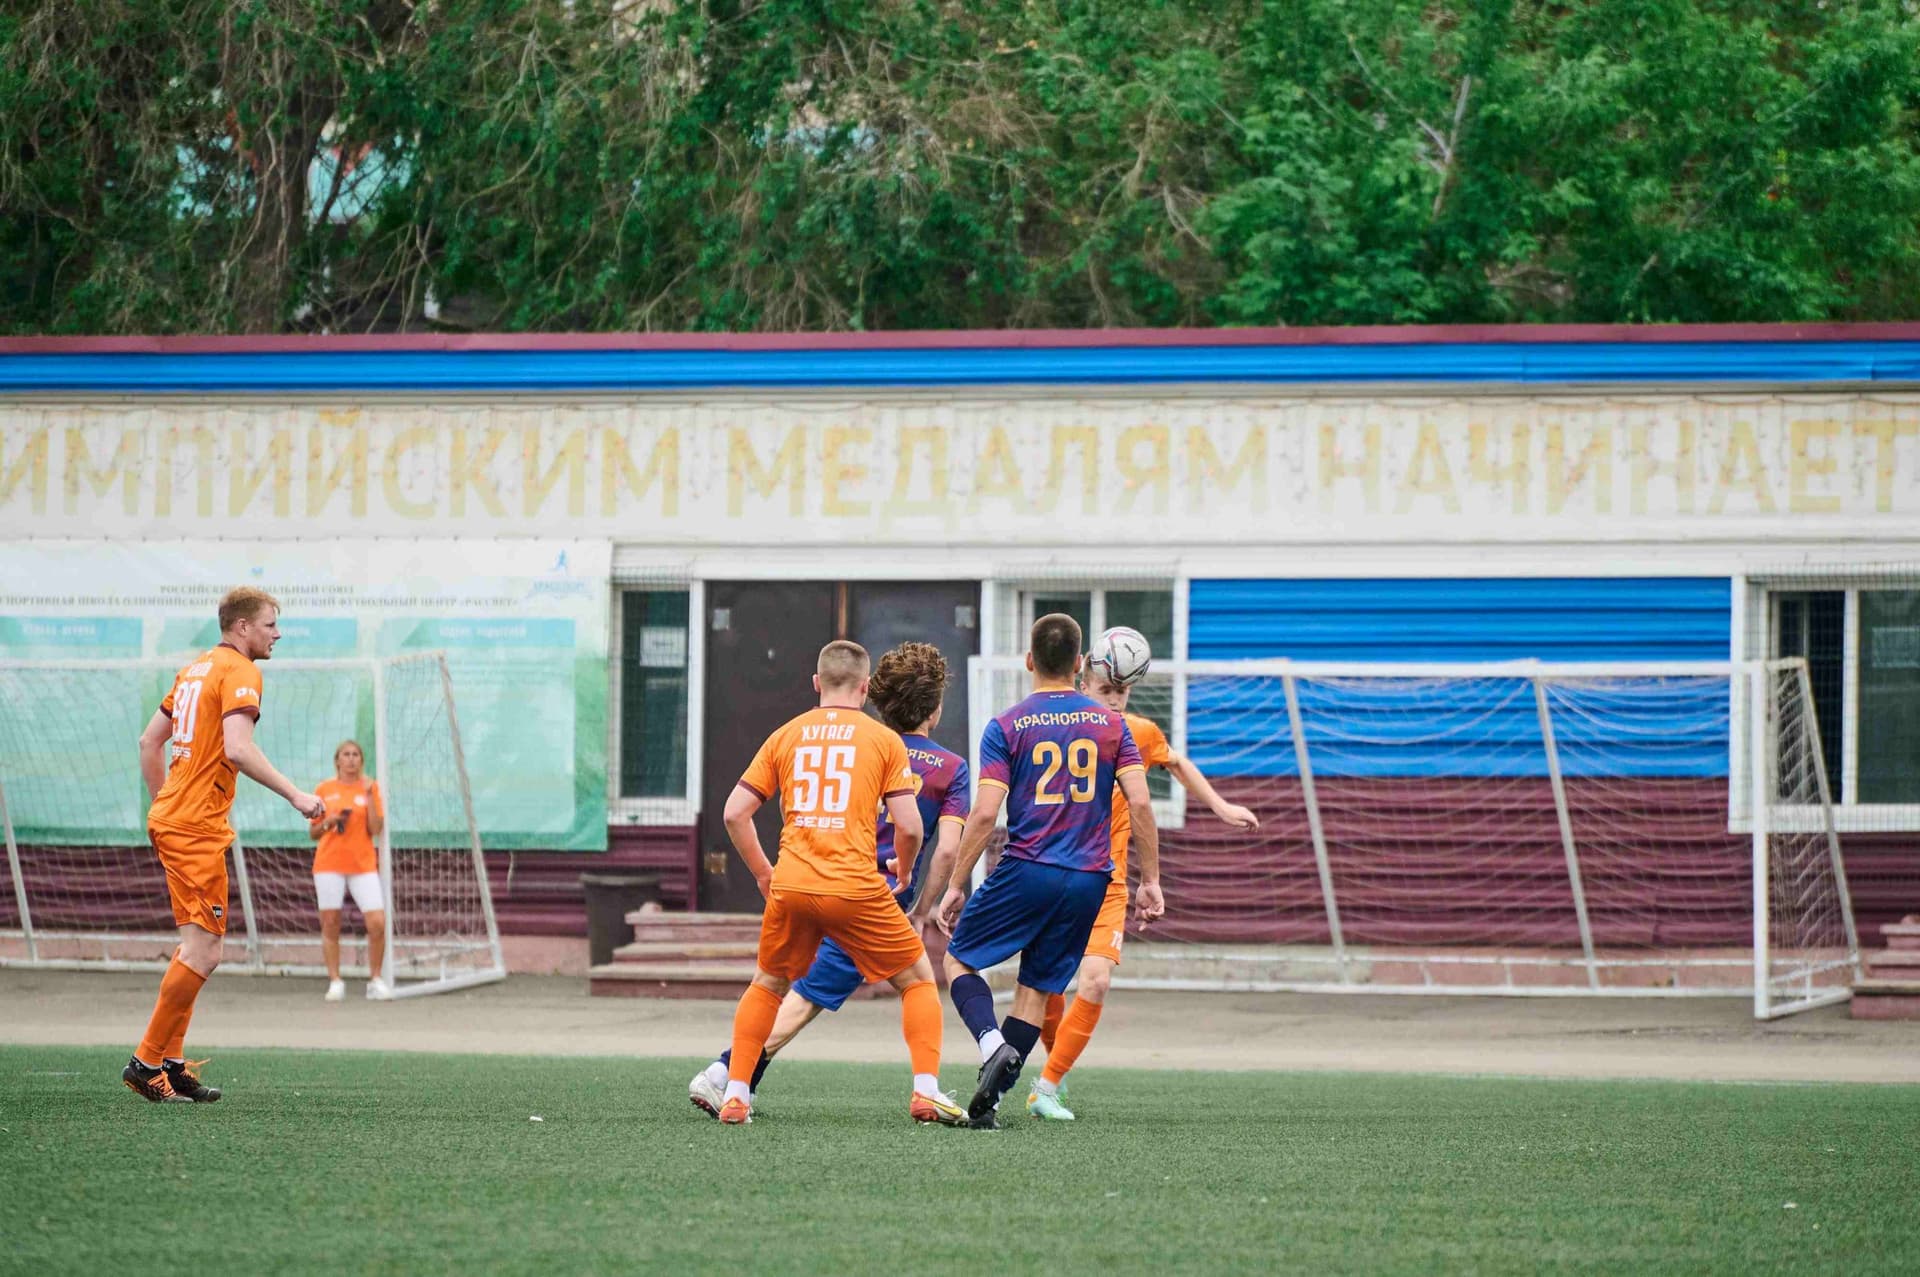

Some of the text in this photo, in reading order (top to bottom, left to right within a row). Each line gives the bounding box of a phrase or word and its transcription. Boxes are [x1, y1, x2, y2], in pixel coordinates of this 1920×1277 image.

[726, 424, 1268, 532] МЕДАЛЯМ
[1317, 418, 1919, 514] НАЧИНАЕТ
[1013, 711, 1109, 732] КРАСНОЯРСК
[793, 745, 857, 813] 55
[1032, 738, 1099, 805] 29
